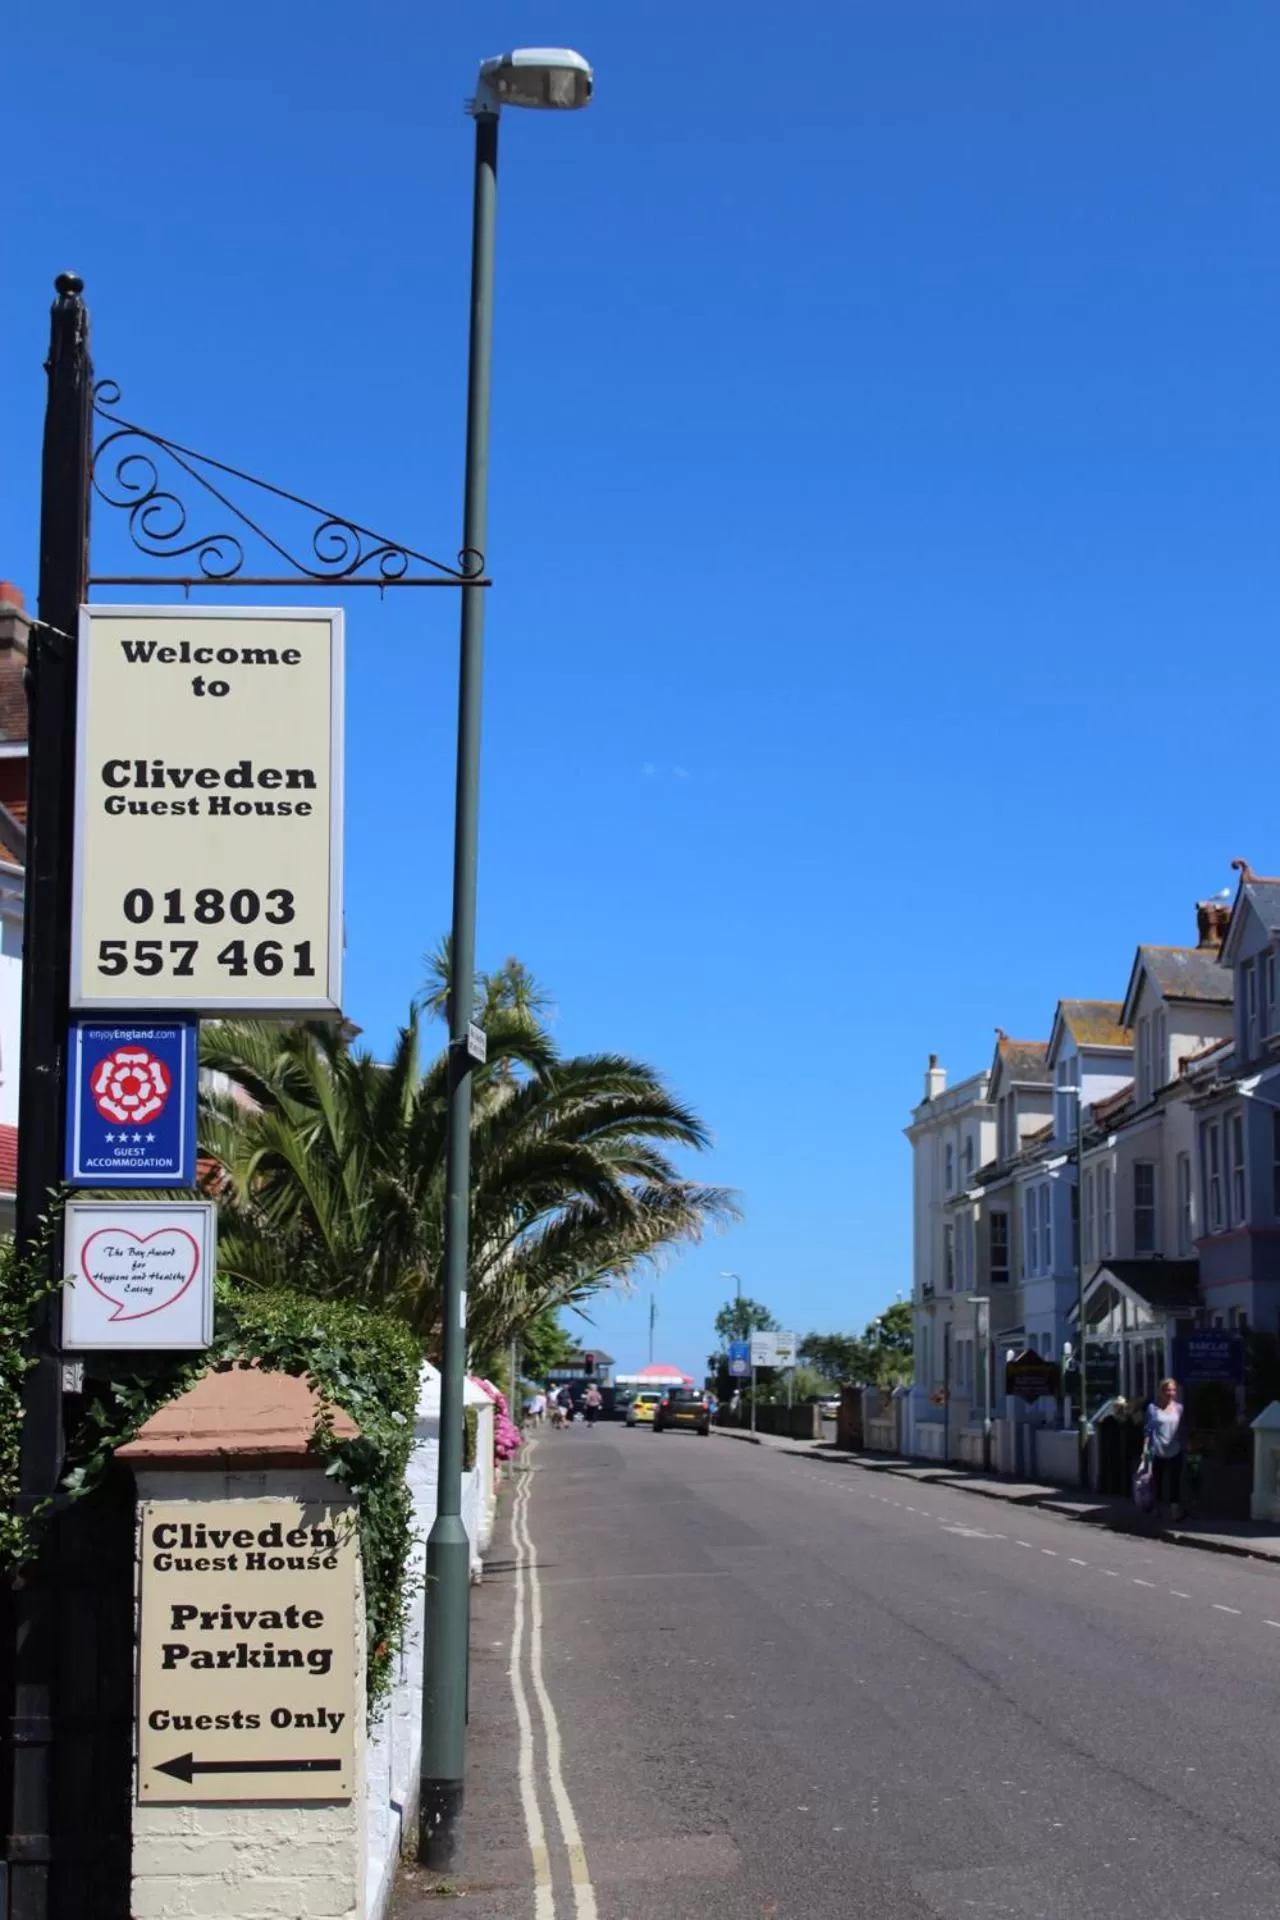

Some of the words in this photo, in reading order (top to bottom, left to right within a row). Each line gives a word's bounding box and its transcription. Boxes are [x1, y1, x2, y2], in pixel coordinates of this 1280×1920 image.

[122, 640, 301, 665] Welcome
[192, 675, 229, 697] to
[102, 760, 316, 789] Cliveden
[105, 796, 199, 816] Guest
[209, 796, 312, 816] House
[123, 888, 294, 924] 01803
[98, 941, 198, 976] 557
[217, 941, 315, 976] 461
[89, 1029, 175, 1040] enjoyEngland.com
[86, 1158, 172, 1166] ACCOMMODATION
[114, 1148, 146, 1156] GUEST
[104, 1247, 123, 1257] The
[147, 1247, 176, 1257] Award
[132, 1260, 146, 1271] for
[93, 1272, 128, 1283] Hygiene
[148, 1272, 185, 1282] Healthy
[124, 1284, 154, 1294] Eating
[152, 1522, 337, 1549] Cliveden
[153, 1552, 237, 1572] Guest
[245, 1551, 338, 1571] House
[170, 1604, 324, 1630] Private
[161, 1642, 333, 1675] Parking
[148, 1709, 260, 1730] Guests
[271, 1707, 345, 1733] Only
